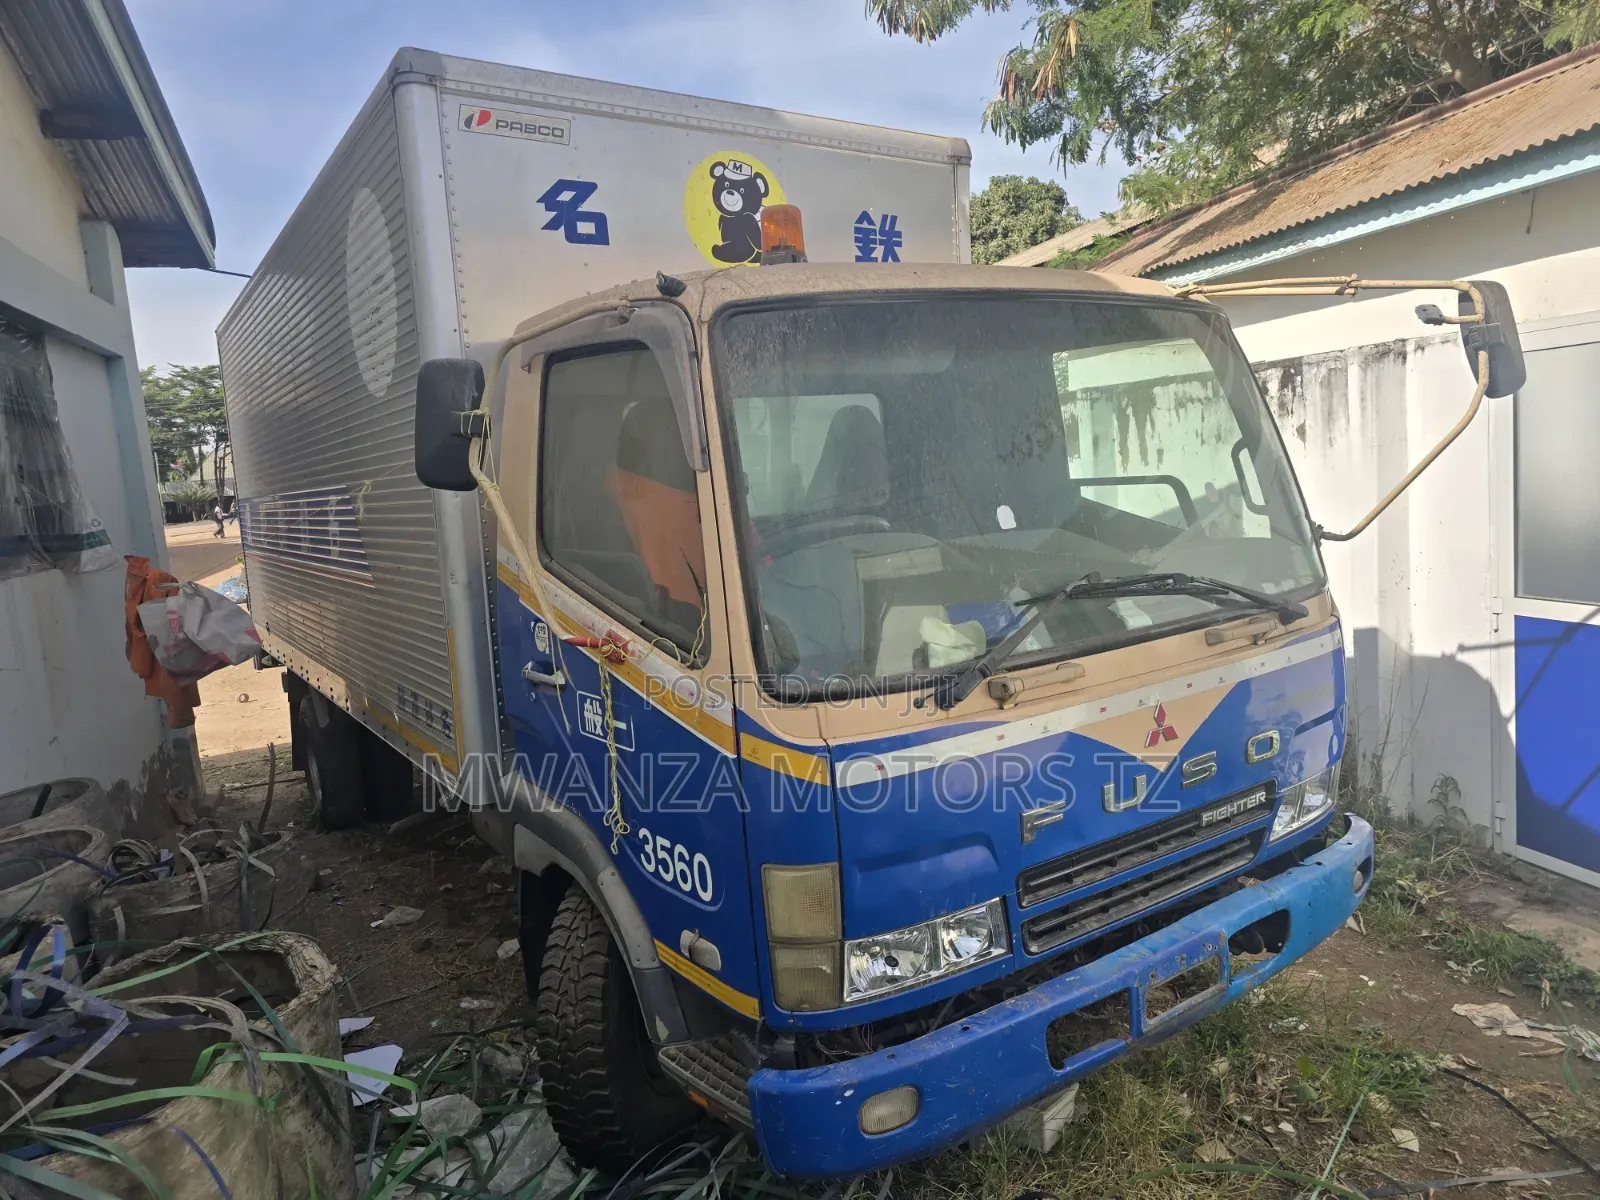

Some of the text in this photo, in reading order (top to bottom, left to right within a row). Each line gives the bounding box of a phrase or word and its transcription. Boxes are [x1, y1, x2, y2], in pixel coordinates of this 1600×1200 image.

[495, 119, 565, 139] PABCO
[732, 161, 743, 173] M
[1020, 731, 1281, 845] FUSO
[1201, 791, 1267, 827] FIGHTER
[637, 827, 713, 902] 3560
